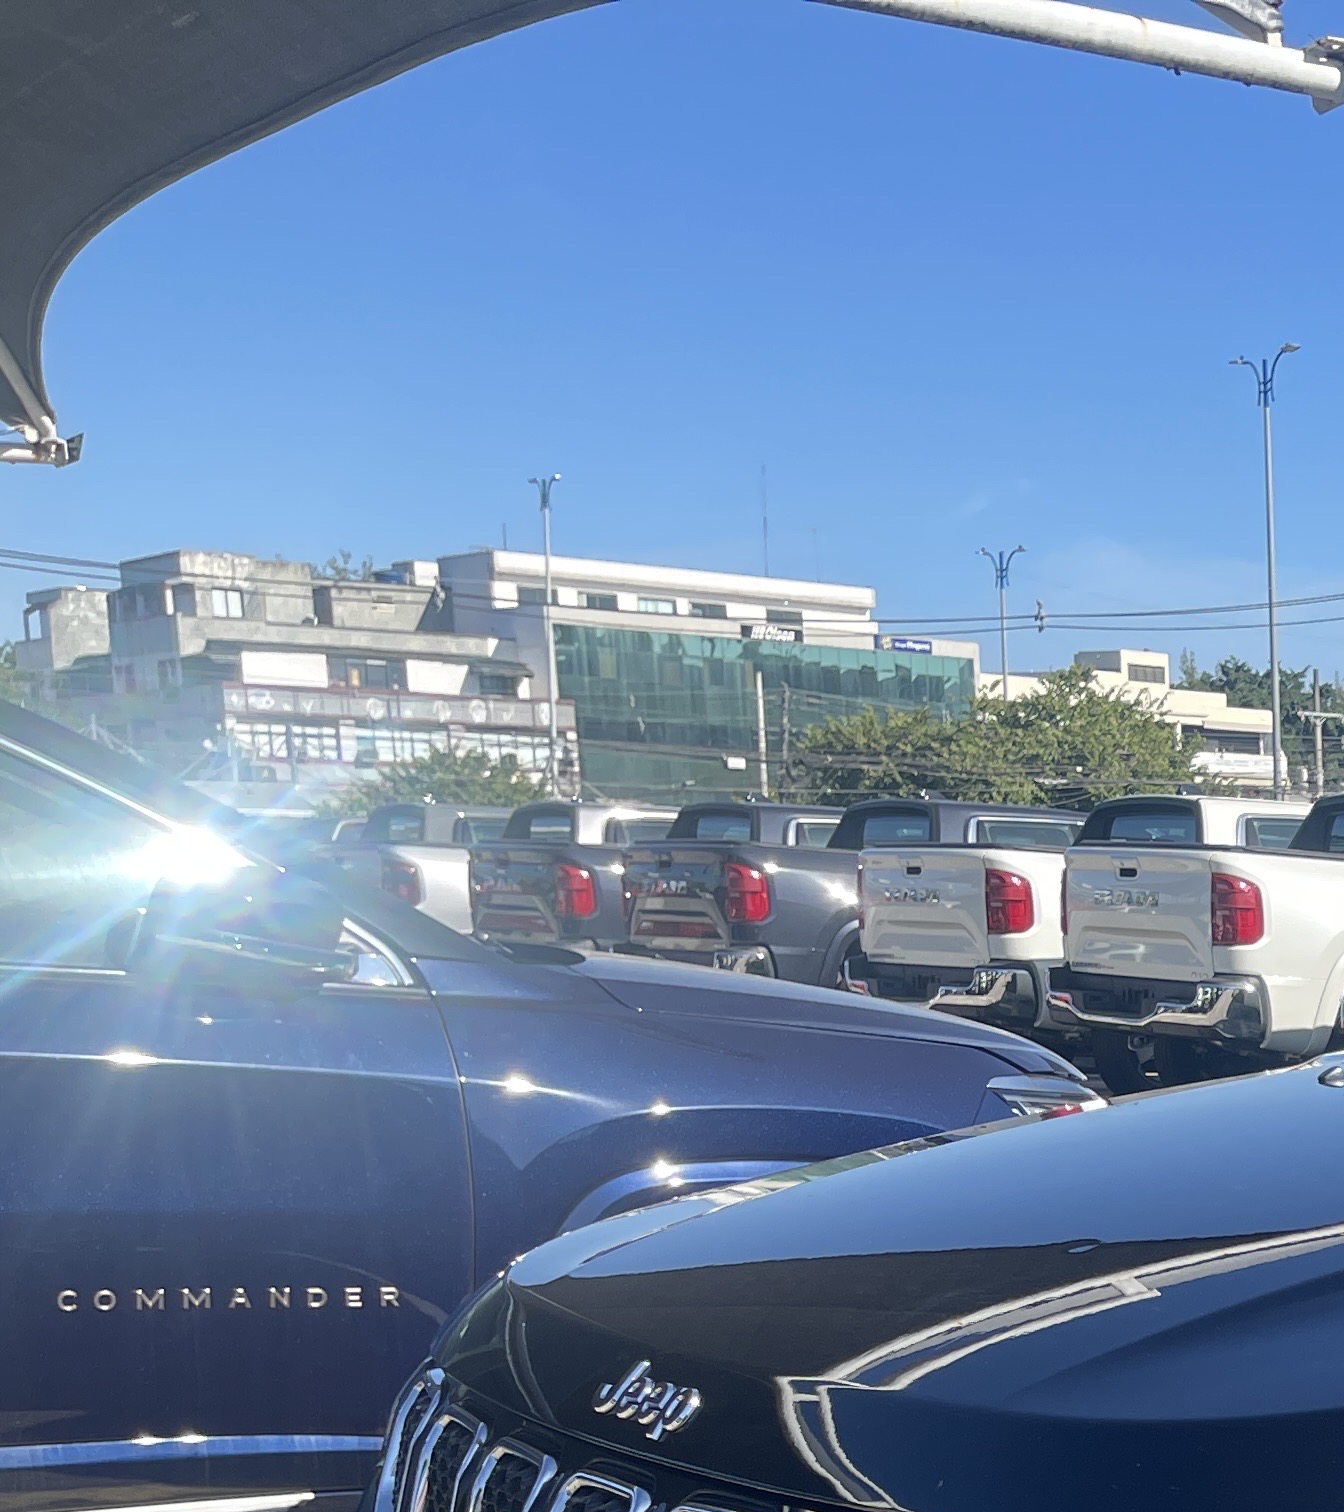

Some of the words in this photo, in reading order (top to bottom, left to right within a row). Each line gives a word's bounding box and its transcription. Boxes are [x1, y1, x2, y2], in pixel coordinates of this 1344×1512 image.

[1094, 889, 1159, 907] RAM
[57, 1286, 400, 1312] COMMANDER
[594, 1360, 702, 1441] Jeep
